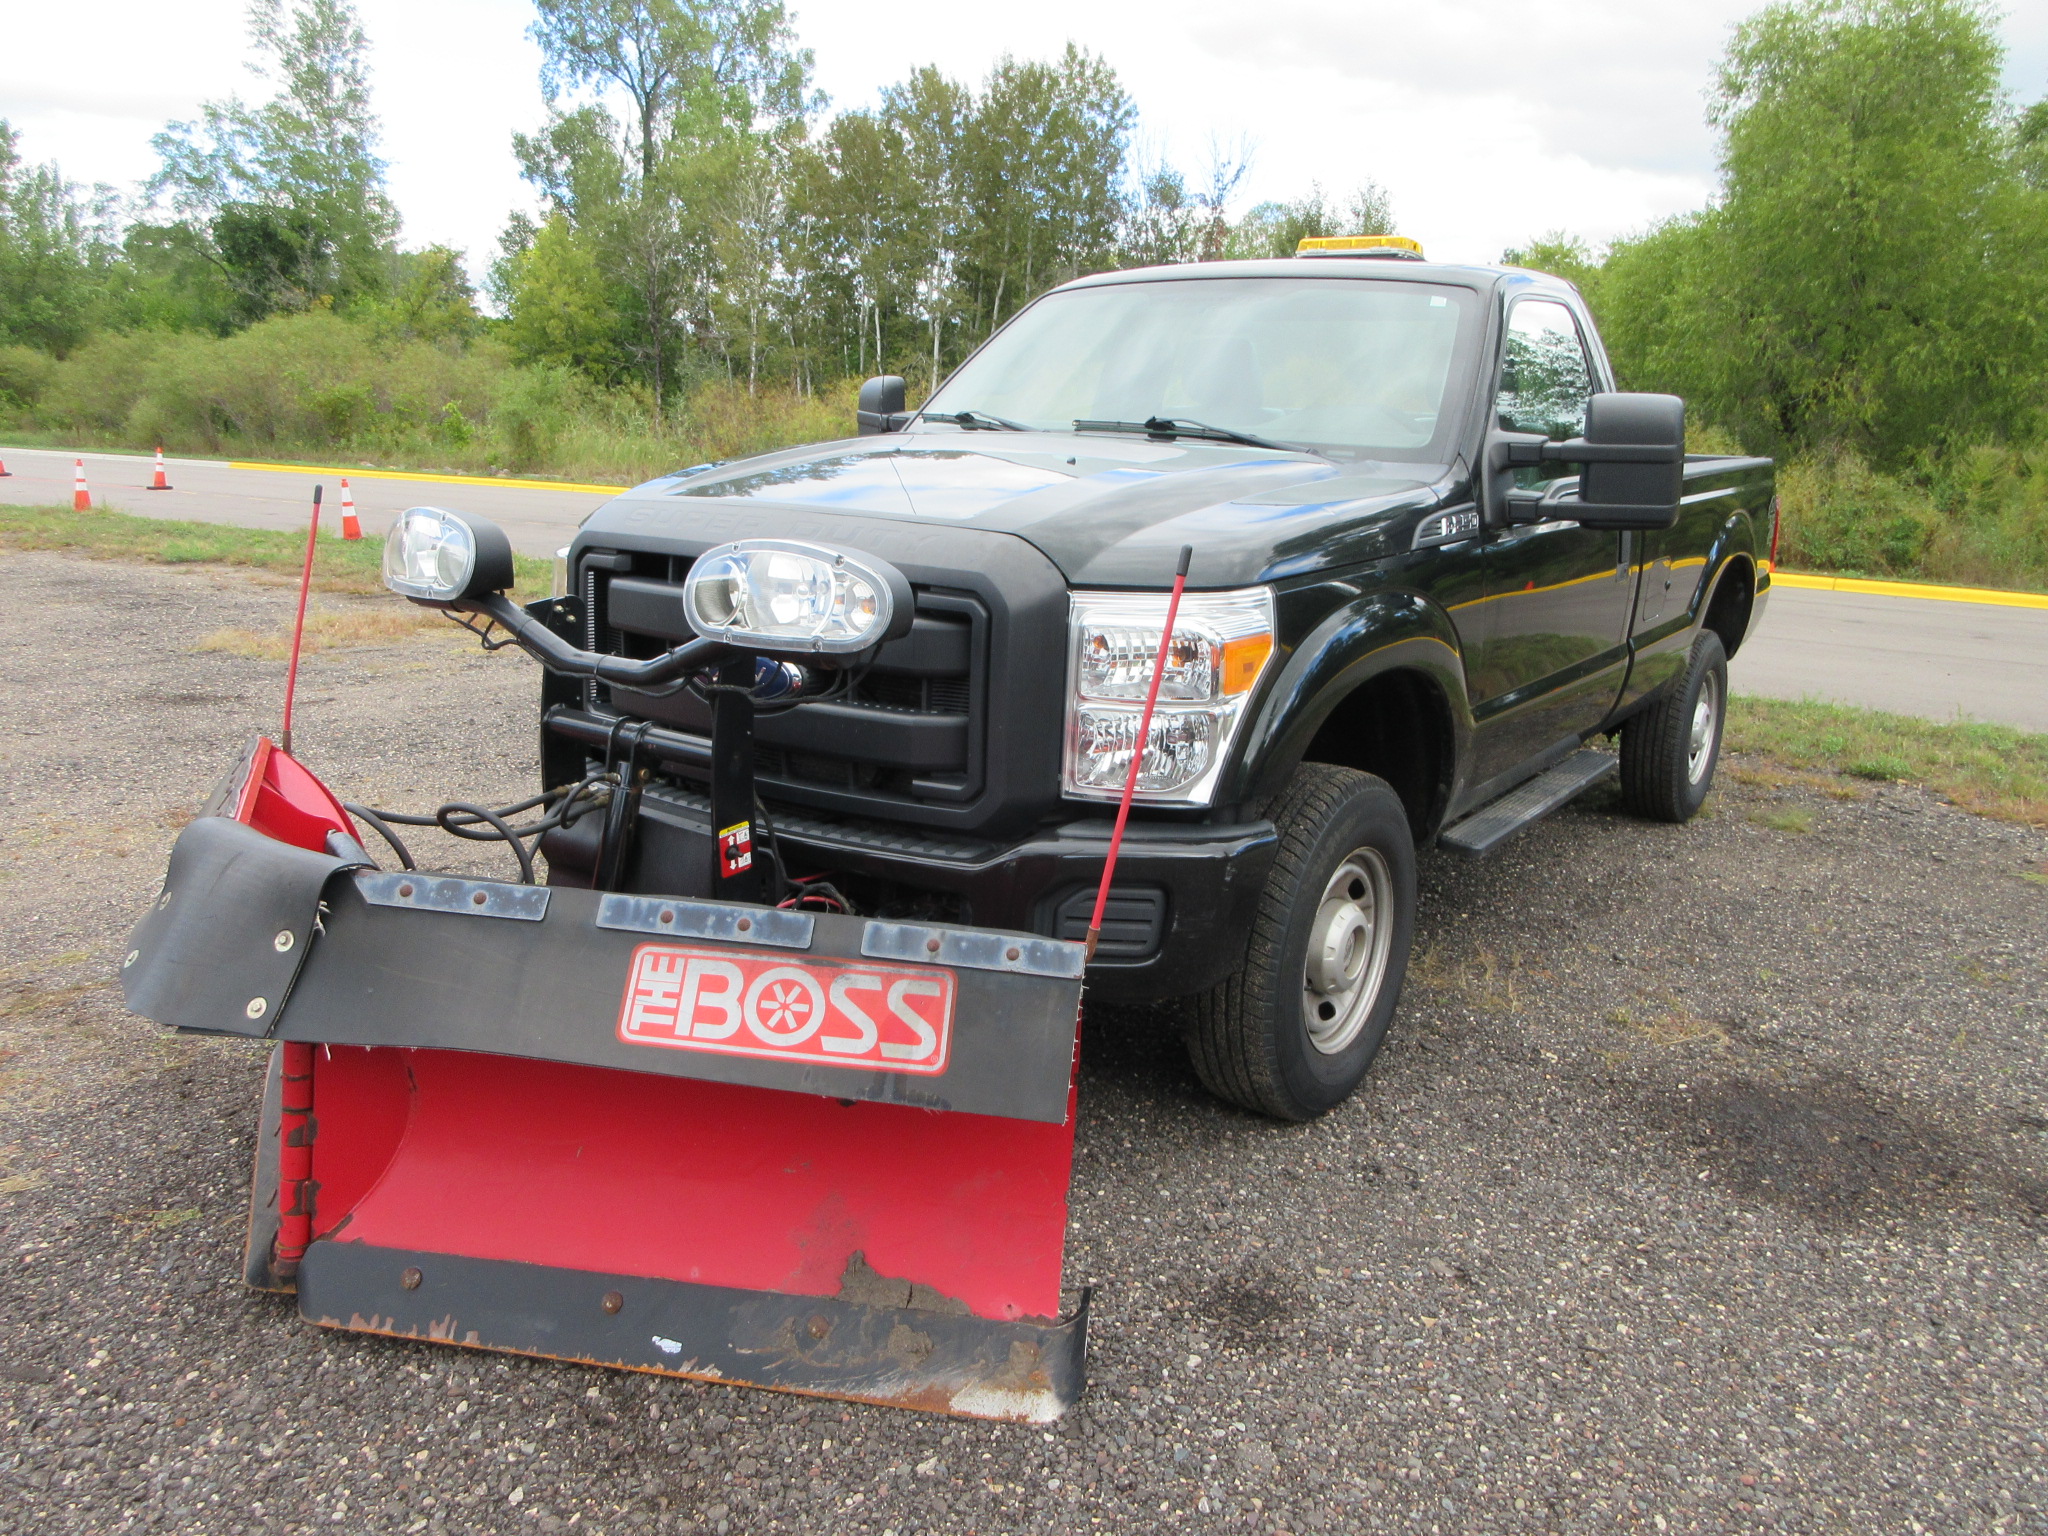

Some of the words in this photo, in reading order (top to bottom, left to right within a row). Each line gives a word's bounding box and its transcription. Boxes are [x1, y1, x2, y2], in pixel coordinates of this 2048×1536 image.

[624, 506, 767, 535] SUPER
[785, 519, 942, 551] DUTY
[629, 954, 685, 1031] THE
[674, 958, 941, 1061] BOSS
